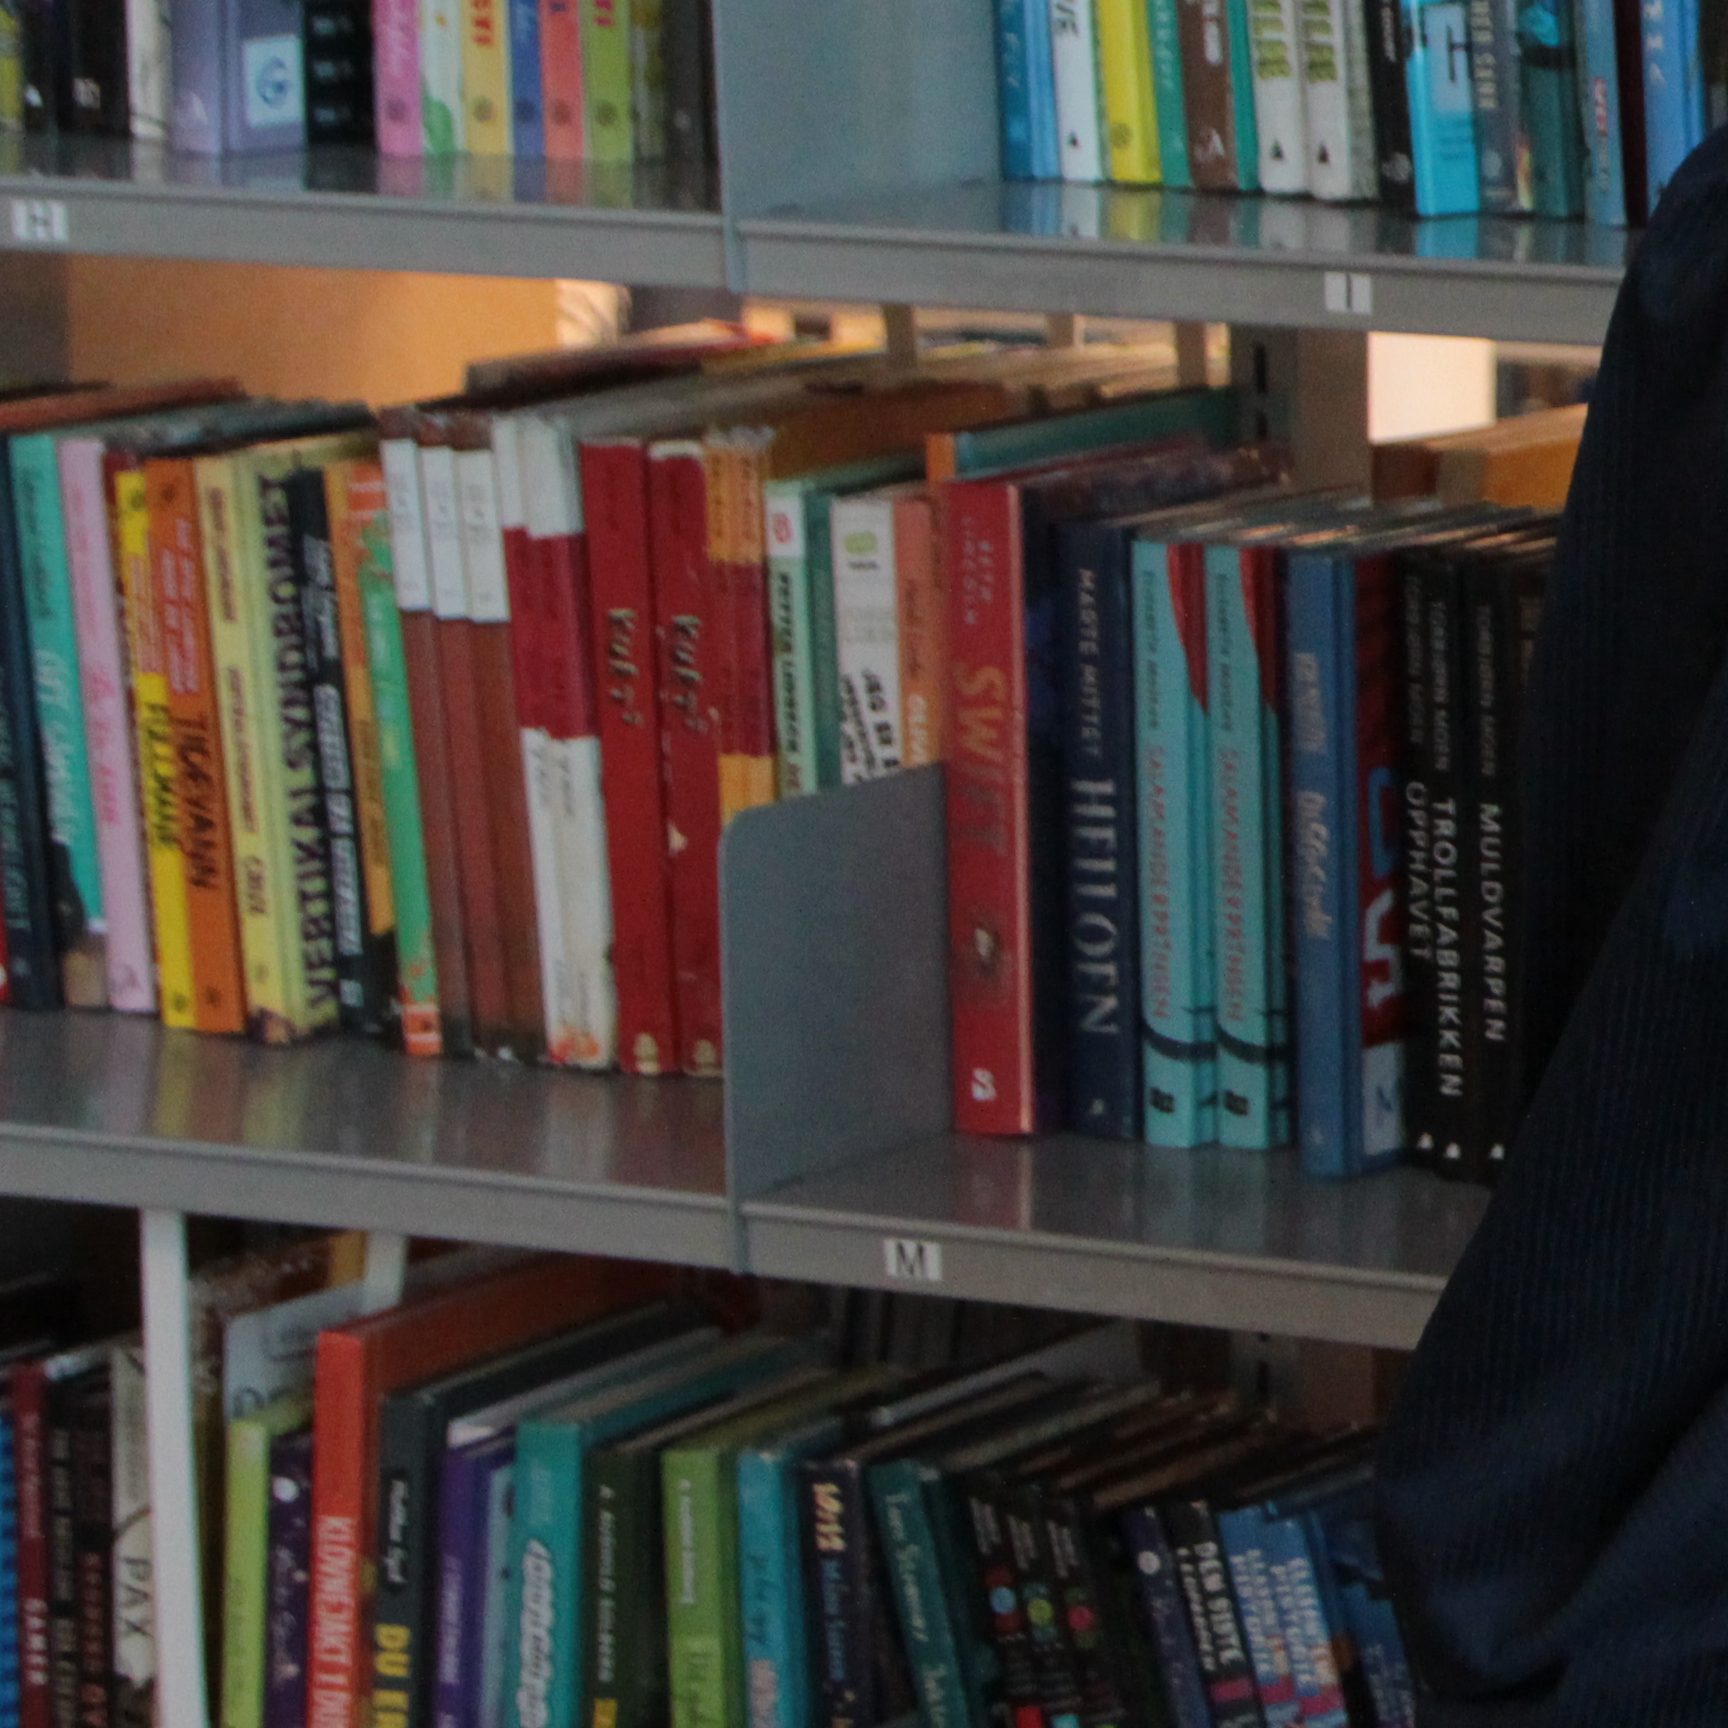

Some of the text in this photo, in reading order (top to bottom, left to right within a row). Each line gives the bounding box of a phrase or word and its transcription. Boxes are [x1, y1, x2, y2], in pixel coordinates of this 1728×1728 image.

[1076, 568, 1100, 655] MARTE
[1404, 779, 1434, 963] OPPHAVET
[1477, 802, 1511, 1043] MULDVARPEN
[1431, 797, 1466, 1099] TROLLFABRIKKEN
[894, 1240, 926, 1277] M
[376, 1624, 411, 1678] DU
